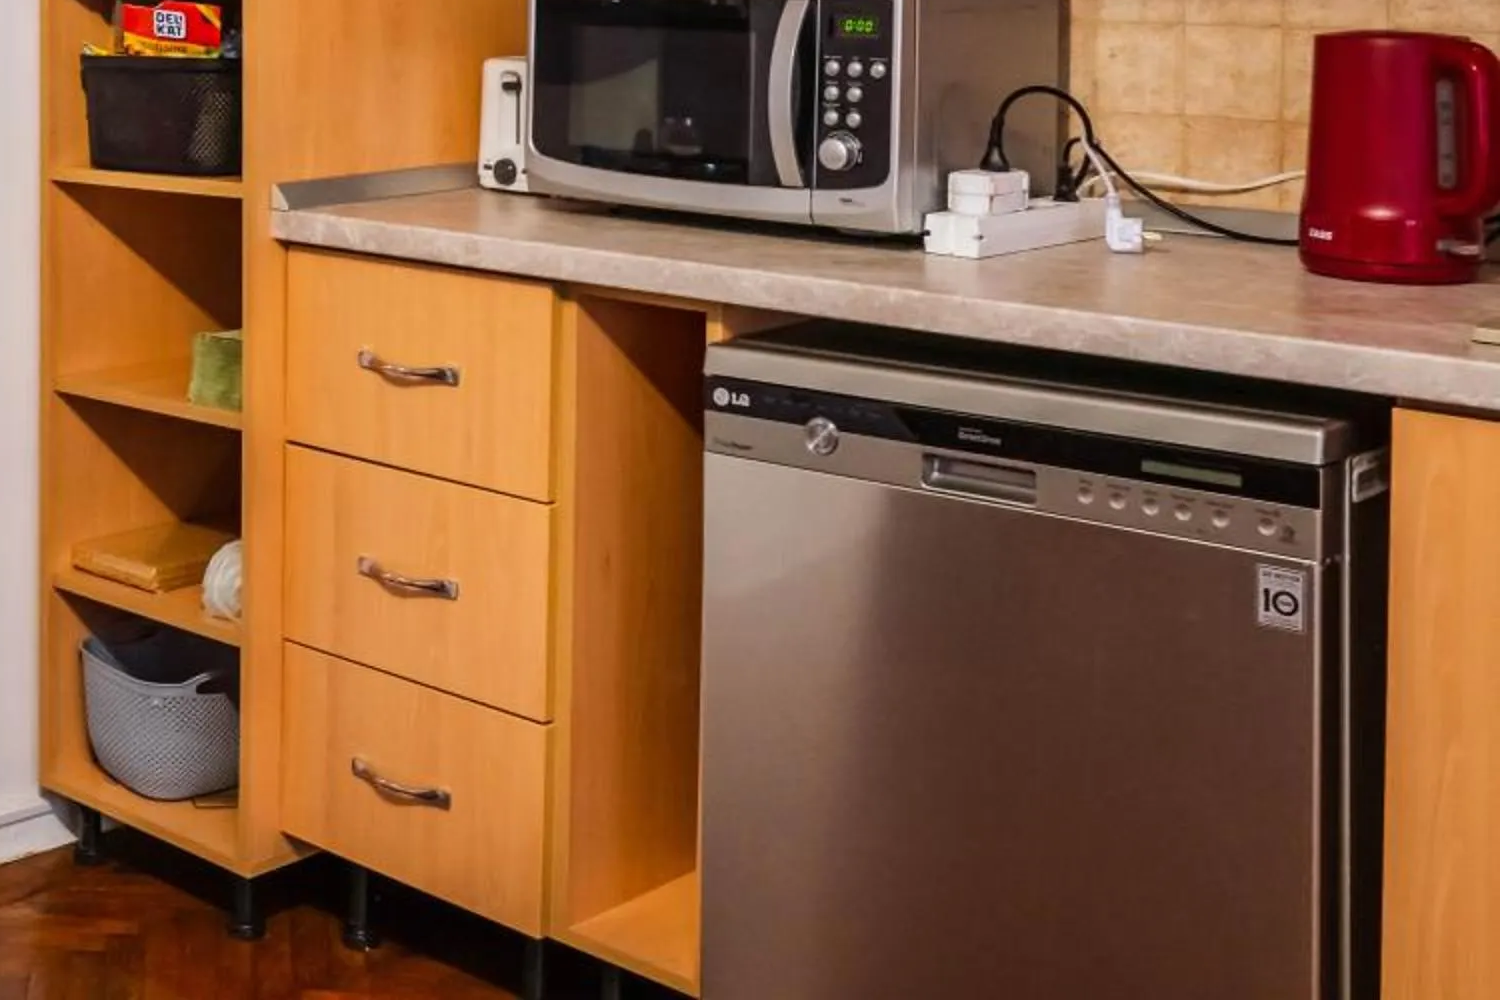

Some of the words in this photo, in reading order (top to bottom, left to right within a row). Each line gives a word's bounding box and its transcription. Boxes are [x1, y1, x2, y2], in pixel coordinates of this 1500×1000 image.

[844, 19, 874, 33] 0:00
[731, 391, 751, 408] LG
[1263, 587, 1299, 617] 10
